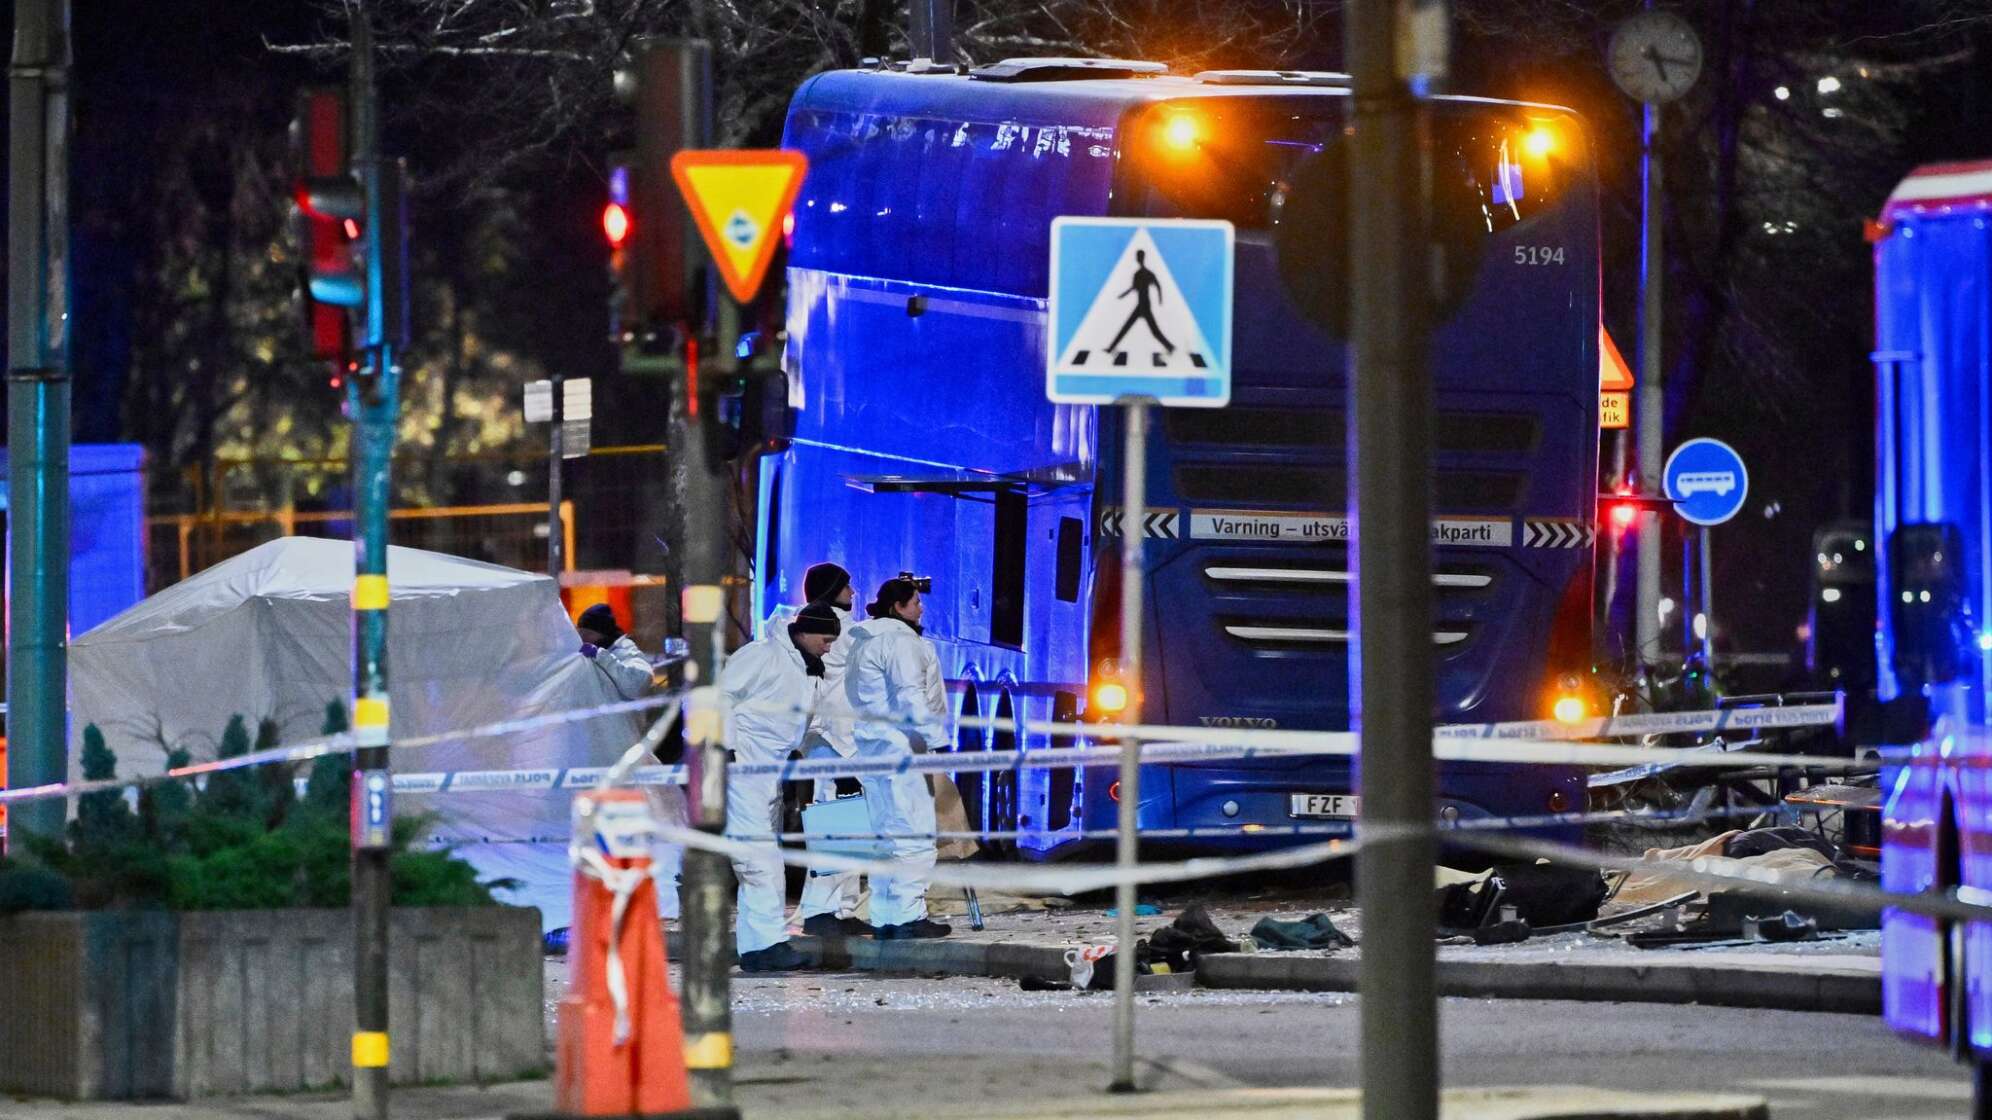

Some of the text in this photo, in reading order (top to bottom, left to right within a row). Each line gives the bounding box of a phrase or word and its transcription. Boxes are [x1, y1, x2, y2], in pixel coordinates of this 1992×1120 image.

[1514, 246, 1565, 266] 5194
[1602, 398, 1618, 408] de
[1603, 413, 1621, 423] fik
[1212, 518, 1280, 538] Varning
[1303, 520, 1349, 537] utsvä
[1431, 524, 1491, 542] akparti
[1199, 715, 1278, 729] VOLVO
[1307, 796, 1343, 814] FZF
